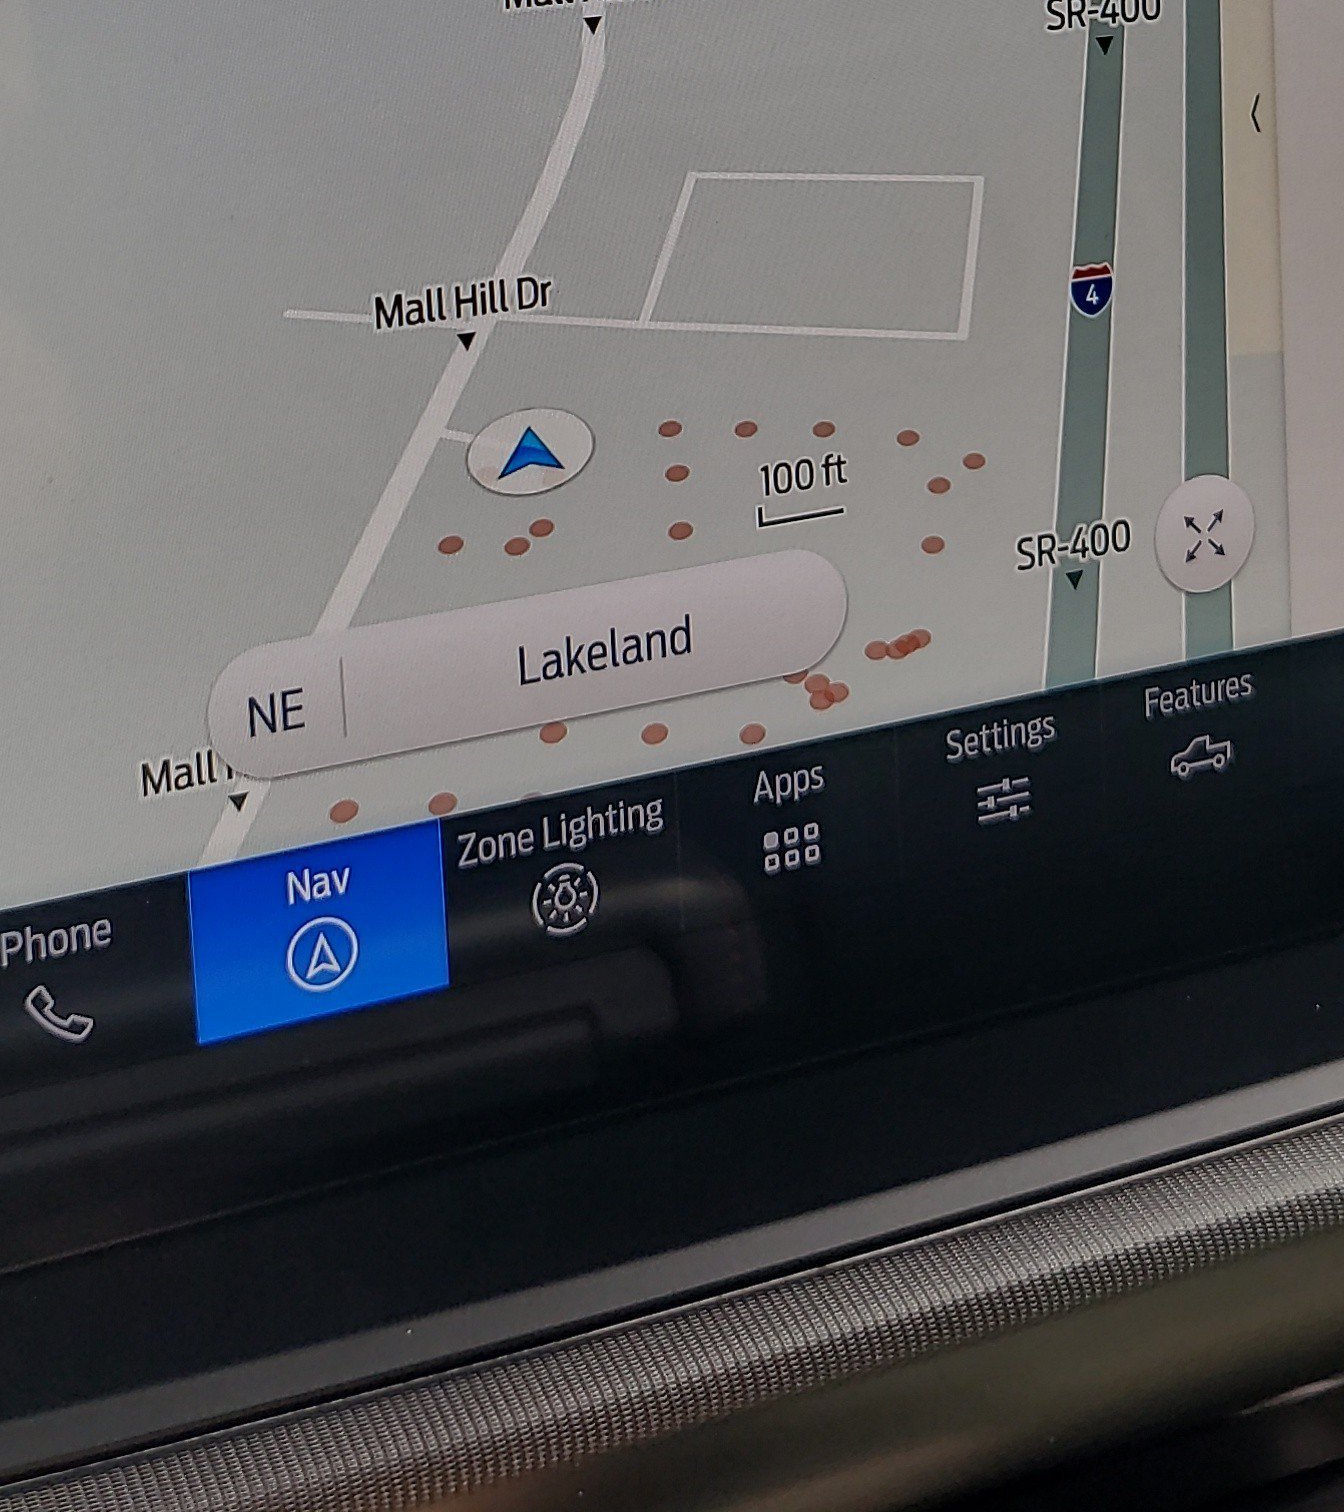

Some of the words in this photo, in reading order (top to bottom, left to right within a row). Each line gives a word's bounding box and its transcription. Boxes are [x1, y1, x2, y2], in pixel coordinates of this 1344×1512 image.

[373, 287, 448, 330] Mall
[454, 279, 510, 318] Hill
[516, 276, 554, 310] Dr
[1085, 284, 1099, 306] 4
[760, 458, 814, 496] 100
[821, 453, 848, 486] ft
[1015, 518, 1132, 572] SR-400
[518, 614, 693, 686] Lakeland
[247, 688, 306, 738] NE
[1143, 669, 1254, 720] Features
[945, 710, 1056, 765] Settings
[141, 749, 217, 797] Mall
[752, 760, 825, 810] Apps
[457, 823, 536, 869] Zone
[543, 795, 664, 850] Lighting
[287, 866, 350, 906] Nav
